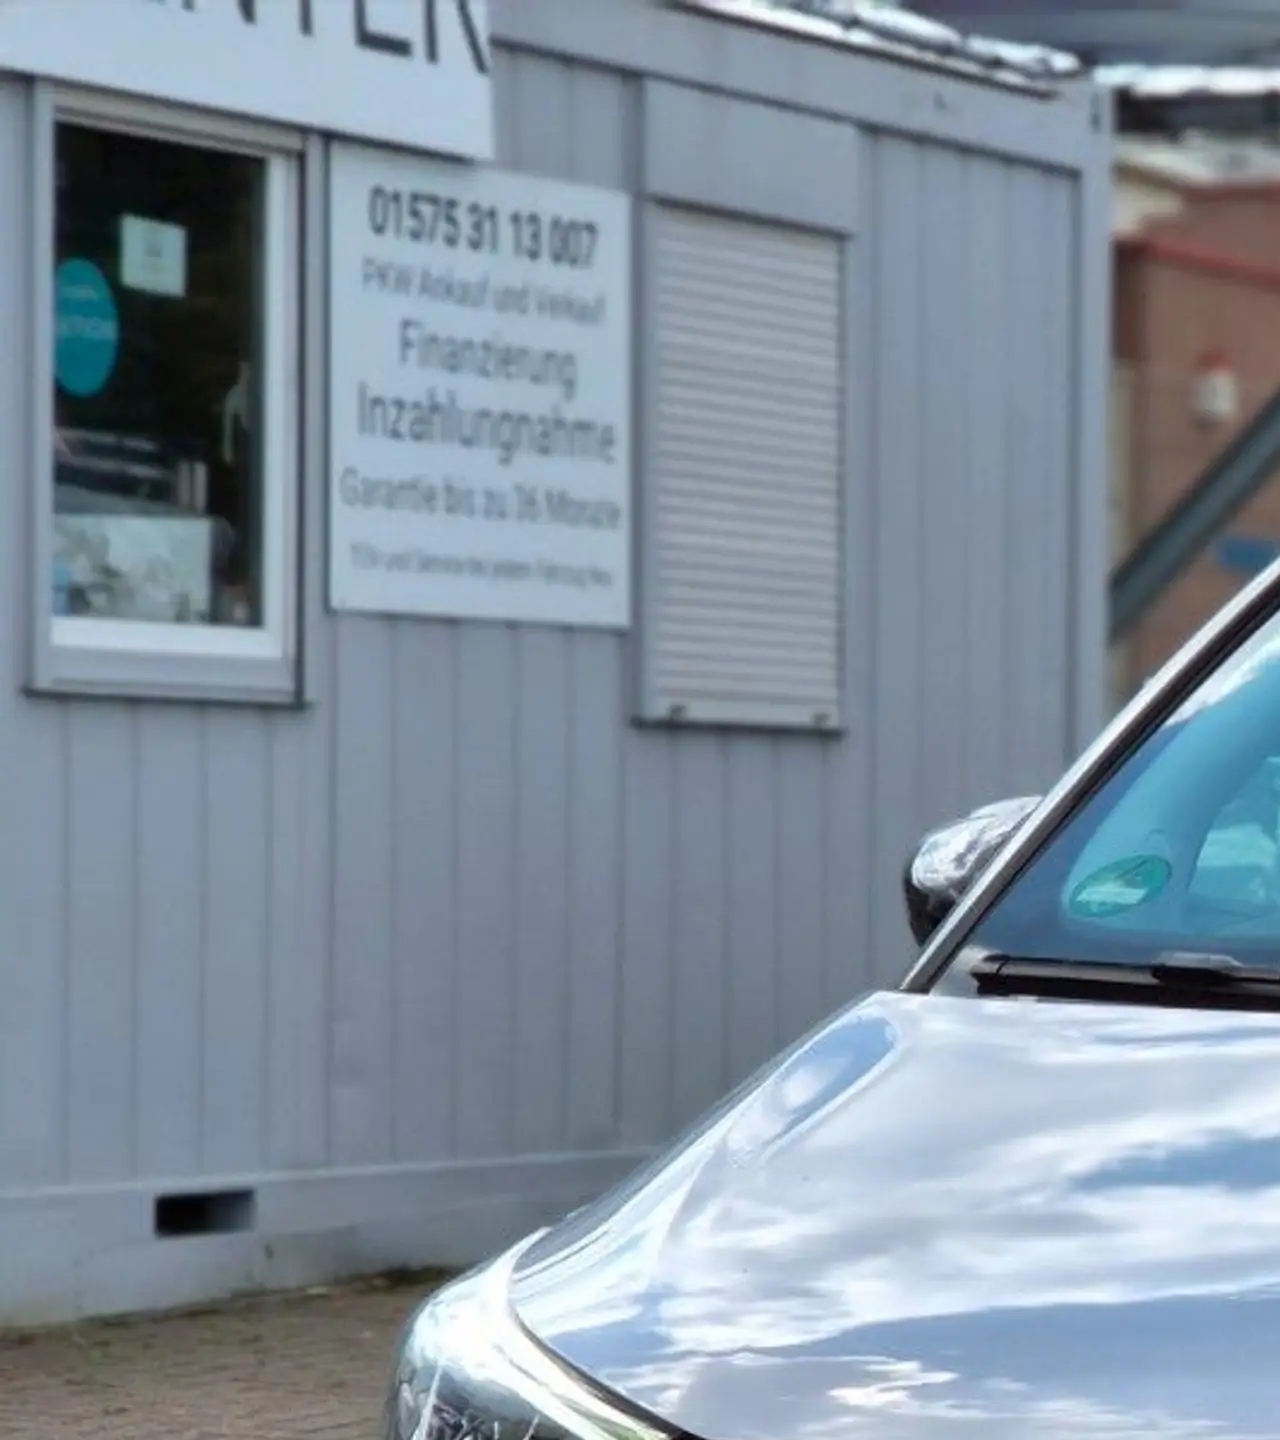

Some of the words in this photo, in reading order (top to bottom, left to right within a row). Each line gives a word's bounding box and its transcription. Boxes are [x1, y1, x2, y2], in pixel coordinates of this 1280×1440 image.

[465, 202, 499, 254] 31
[510, 211, 542, 263] 13
[549, 216, 599, 270] 007
[400, 317, 577, 401] Finanzierung
[356, 381, 617, 465] Inzahlungnahme
